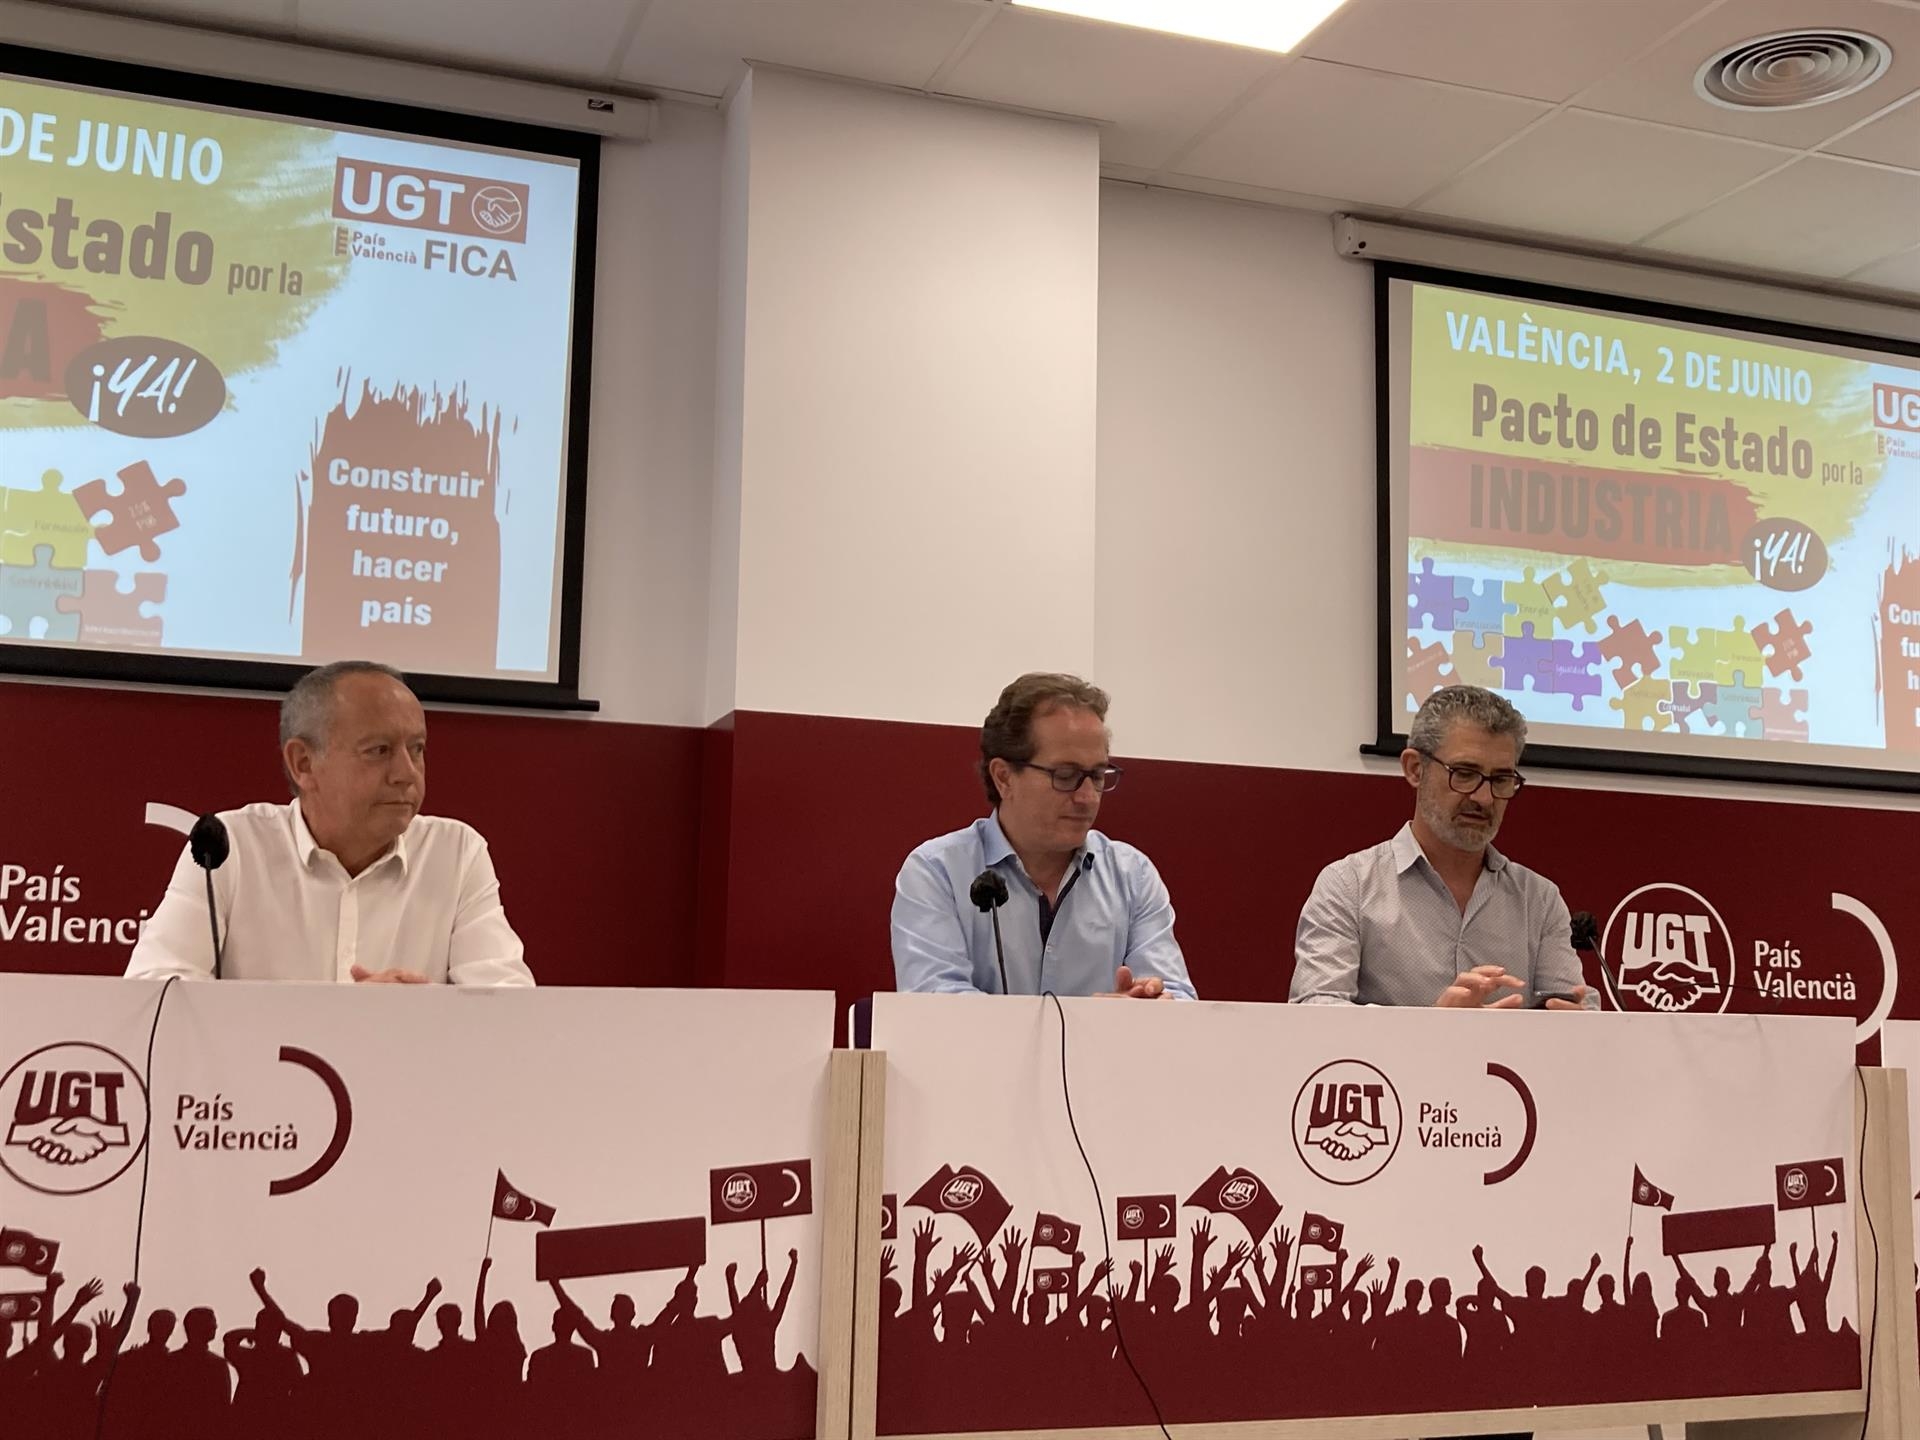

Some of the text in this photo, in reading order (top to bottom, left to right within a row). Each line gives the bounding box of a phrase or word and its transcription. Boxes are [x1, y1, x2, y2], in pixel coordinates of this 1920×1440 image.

[67, 120, 223, 184] JUNIO
[341, 167, 465, 225] UGT
[0, 193, 303, 296] stado por la
[352, 231, 386, 247] País
[352, 244, 417, 264] Valencià
[424, 239, 517, 281] FICA
[1446, 311, 1812, 405] VALÈNCIA, 2 DE JUNIO
[88, 355, 197, 422] ¡YA!
[1472, 383, 1863, 485] Pacto de Estado por la
[328, 458, 484, 499] Construir
[347, 504, 460, 546] futuro,
[1469, 464, 1733, 554] INDUSTRIA
[352, 550, 448, 584] hacer
[1754, 530, 1811, 580] ¡YA!
[0, 864, 81, 903] País
[0, 905, 148, 944] Valenci
[1622, 912, 1711, 968] UGT
[1754, 940, 1801, 969] País
[1754, 973, 1856, 1001] Valencià
[14, 1070, 125, 1125] UGT
[177, 1094, 233, 1121] País
[1310, 1083, 1384, 1127] UGT
[1419, 1101, 1458, 1124] País
[174, 1123, 298, 1150] Valencià
[1418, 1126, 1502, 1148] Valencià
[727, 1180, 751, 1196] UGT
[950, 1180, 979, 1197] UGT
[1228, 1181, 1255, 1197] UGT
